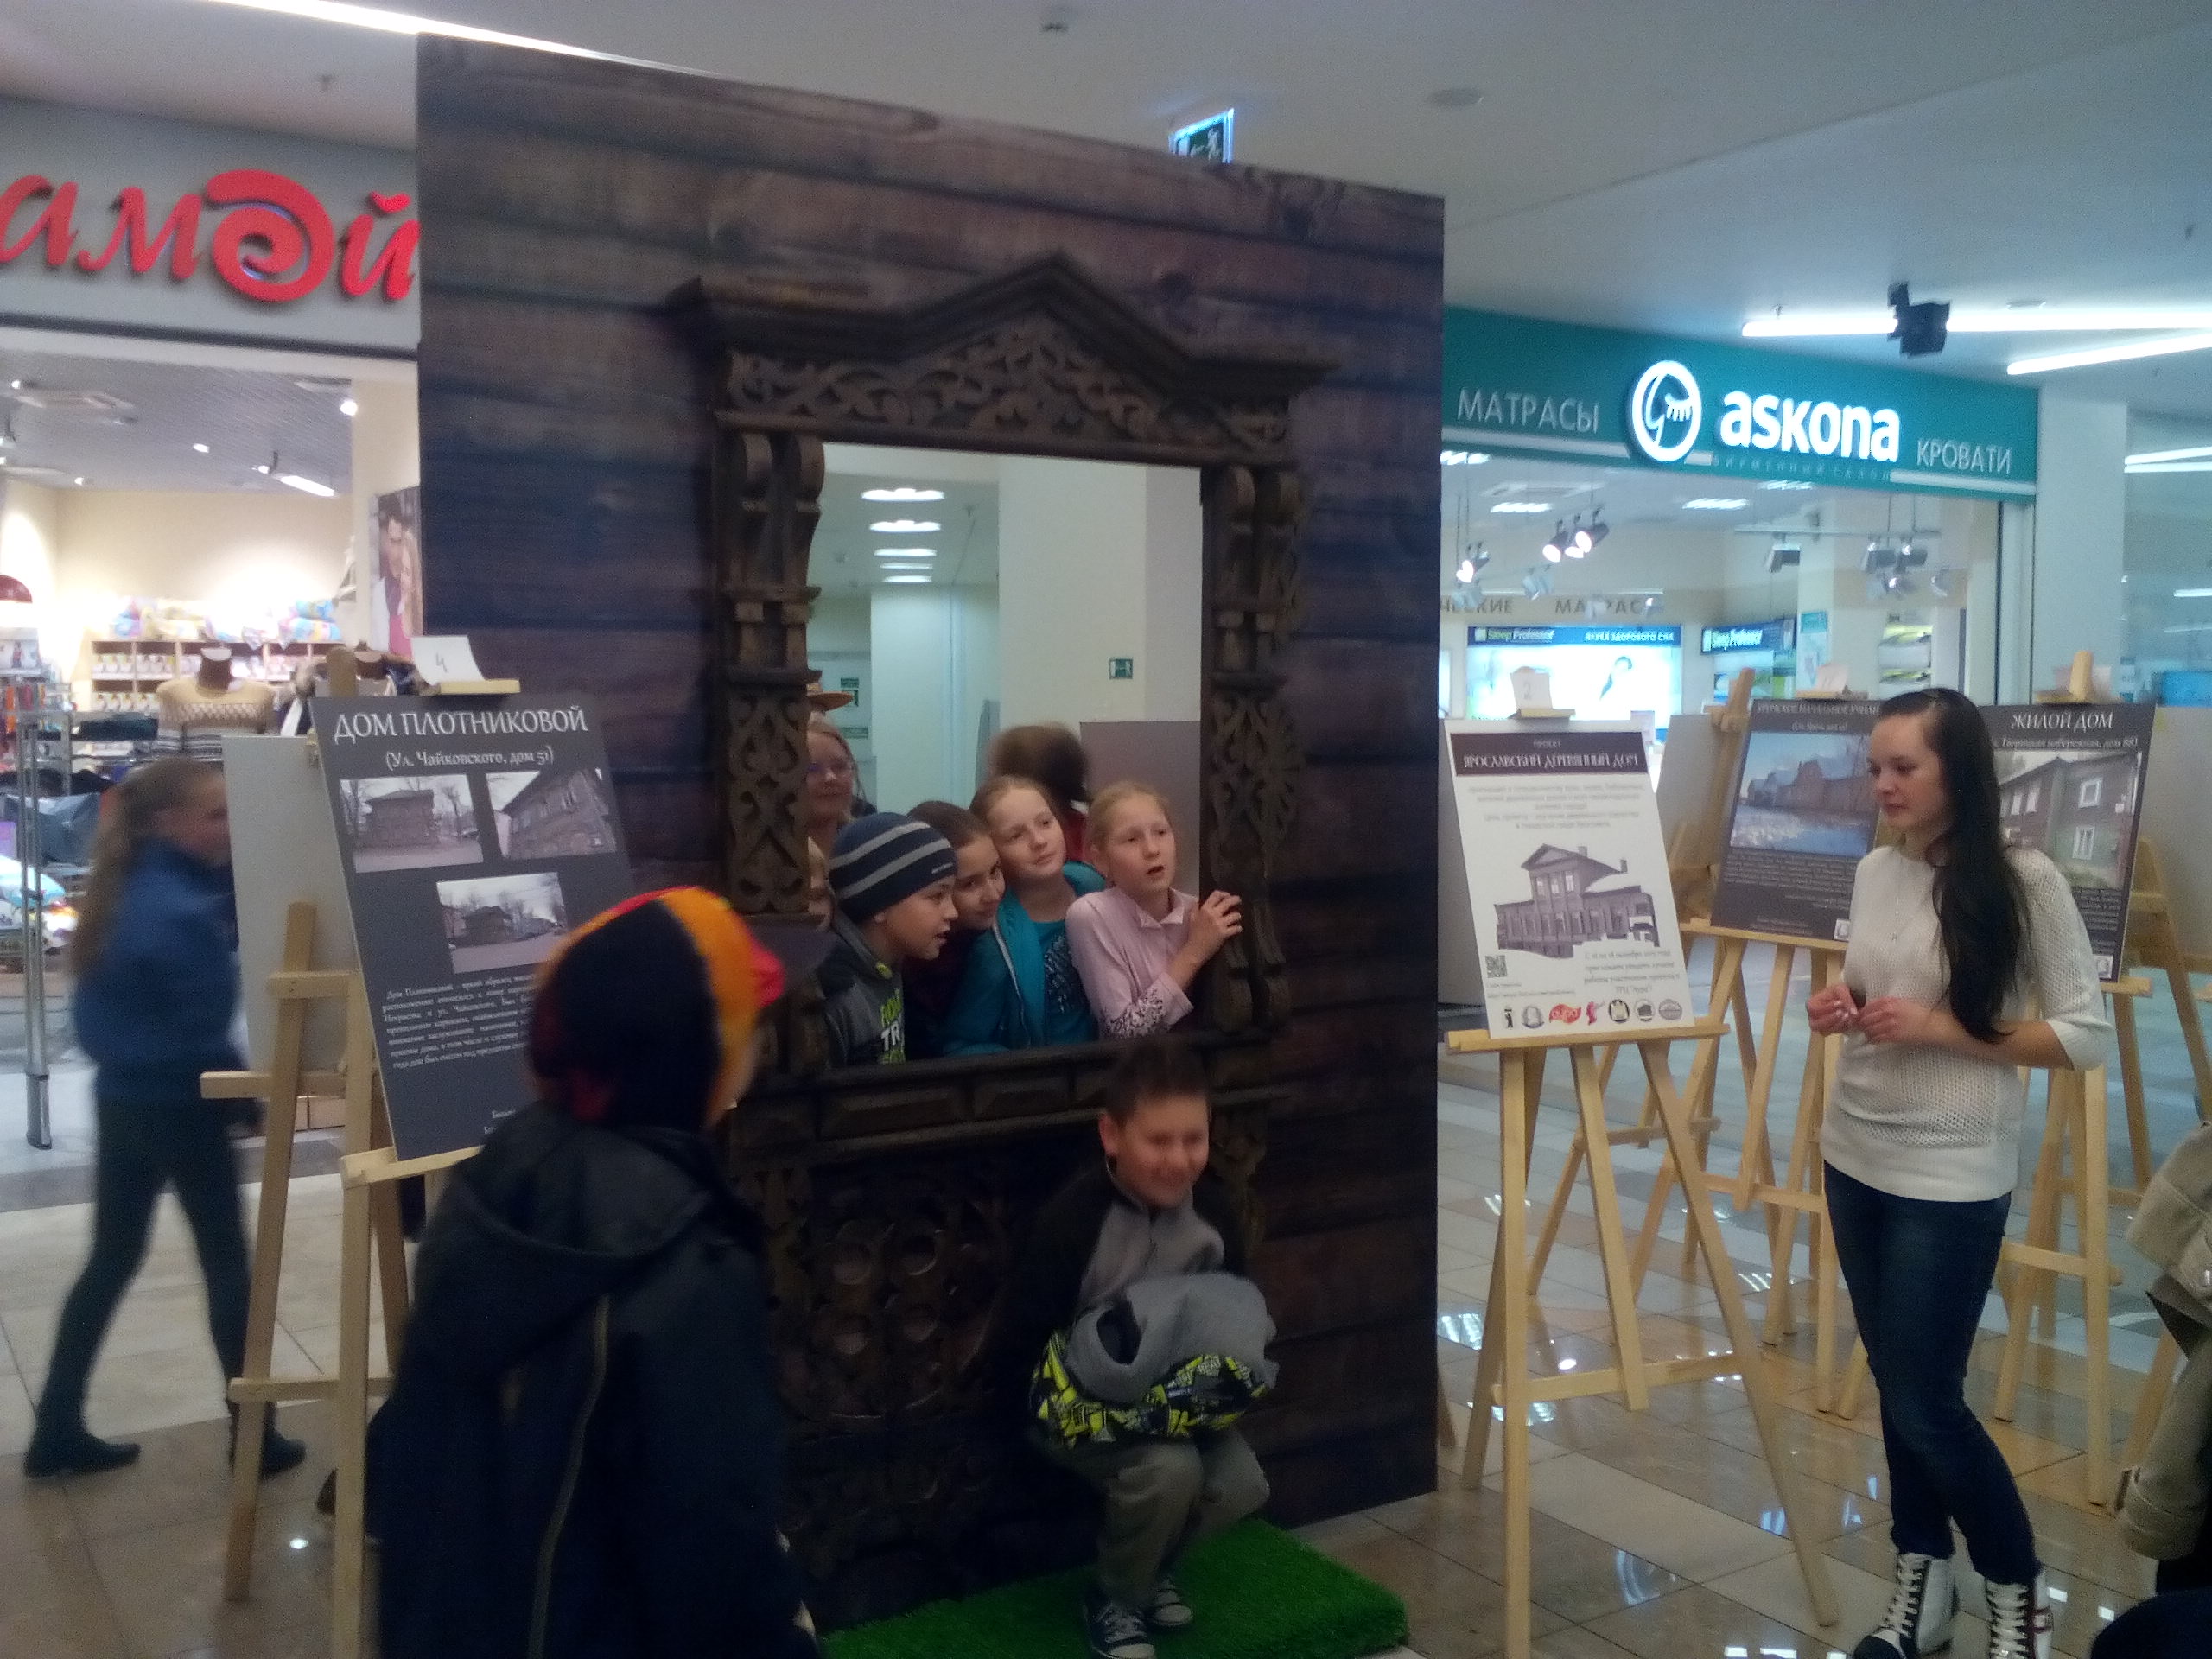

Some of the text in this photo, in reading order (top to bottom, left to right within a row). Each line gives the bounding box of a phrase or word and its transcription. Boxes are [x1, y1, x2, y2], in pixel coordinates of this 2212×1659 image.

[1457, 387, 1599, 434] МАТРАСЫ
[1719, 391, 1900, 462] askona
[1916, 437, 2012, 474] КРОВАТИ
[334, 705, 588, 745] ДОМ ПЛОТНИКОВОЙ
[2011, 708, 2113, 733] ЖИЛОЙ ДОМ
[511, 753, 534, 766] дом
